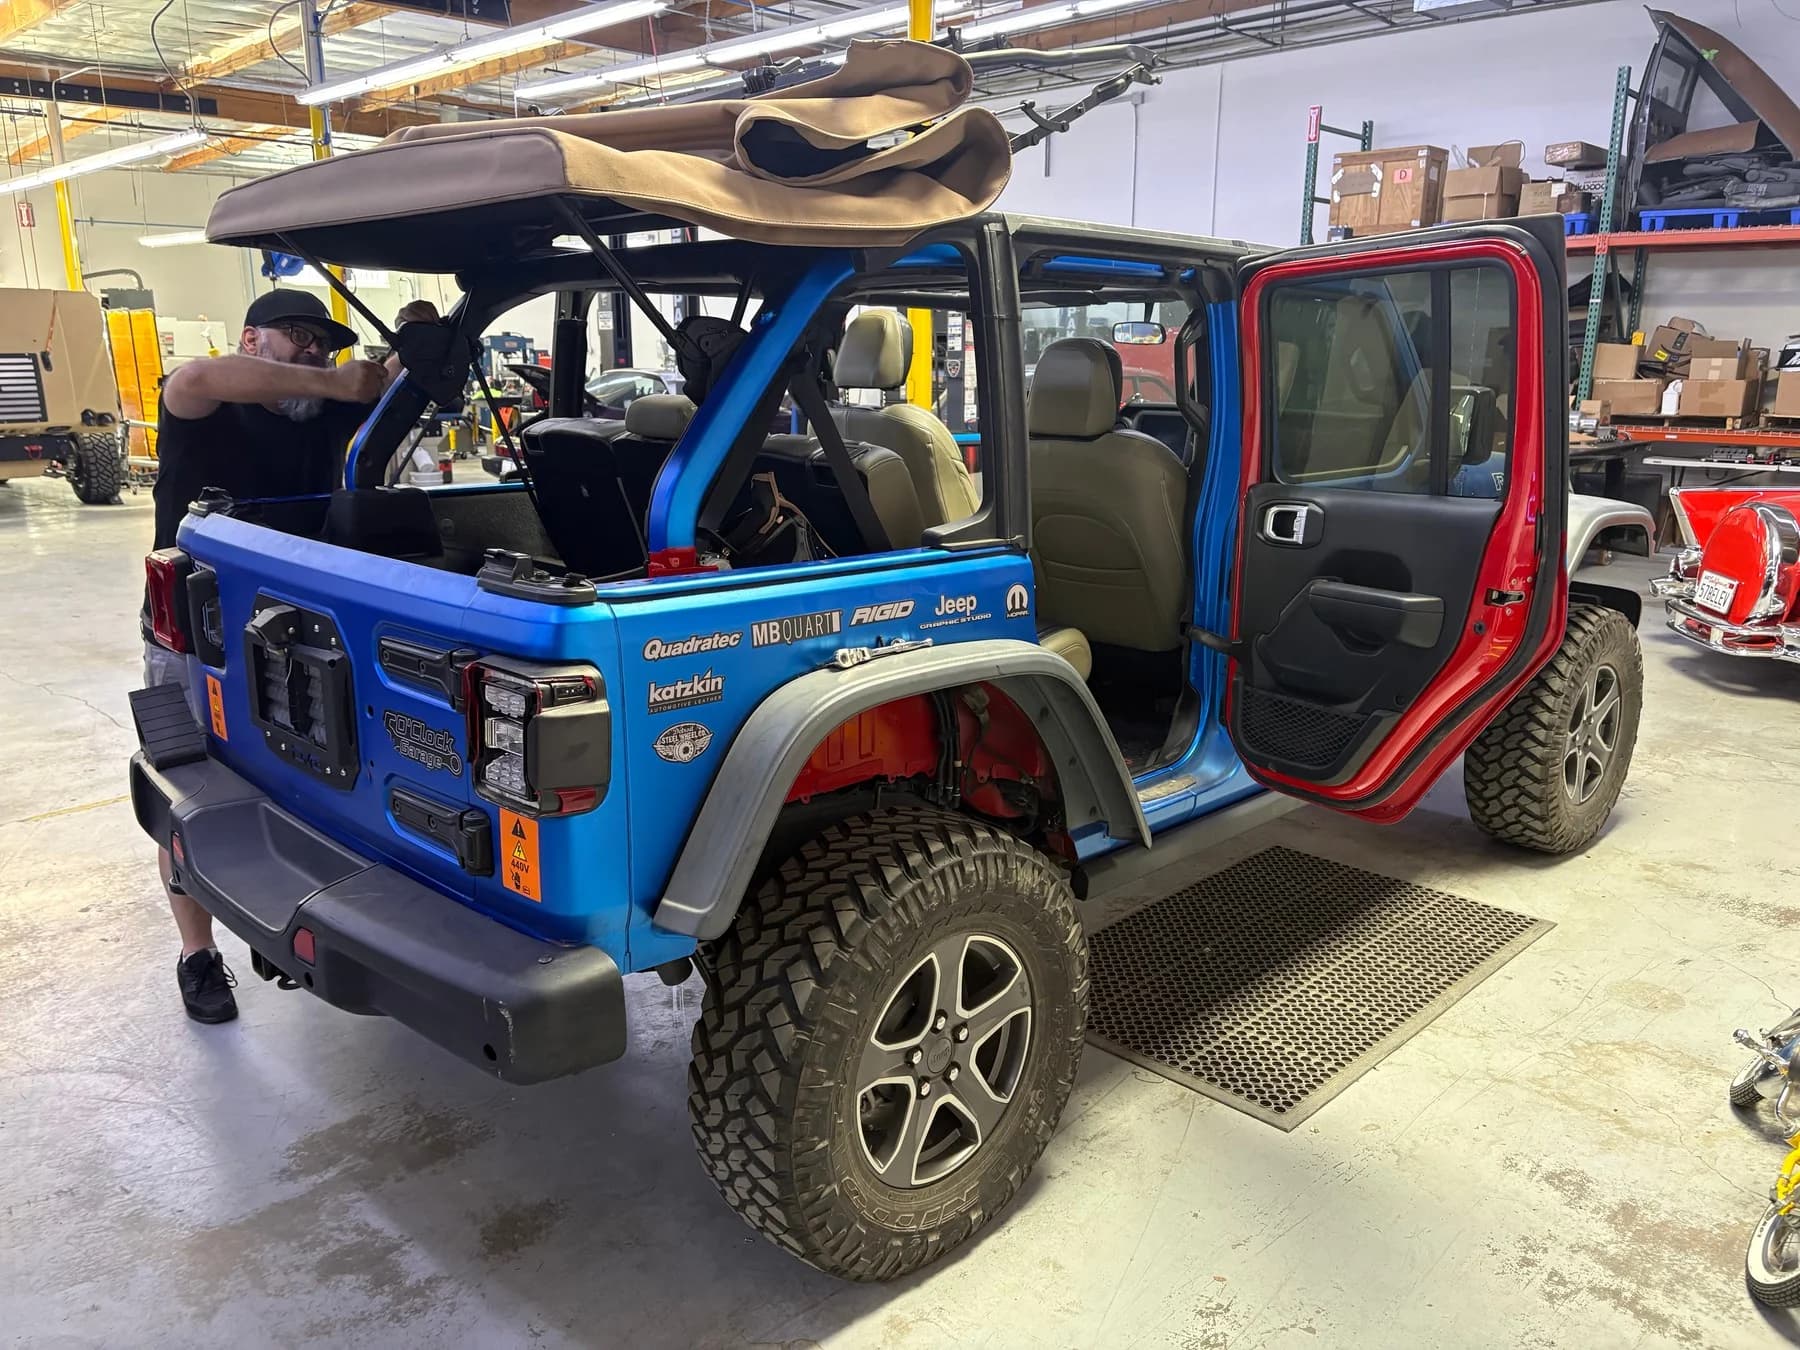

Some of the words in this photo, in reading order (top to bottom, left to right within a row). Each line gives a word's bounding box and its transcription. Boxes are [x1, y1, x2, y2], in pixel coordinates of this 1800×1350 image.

[1399, 170, 1408, 181] D
[850, 600, 915, 627] RIGID
[935, 595, 977, 616] Jeep
[920, 618, 960, 630] GRAPHIC
[960, 613, 992, 623] STUDIO
[643, 632, 742, 661] Quadratec
[650, 668, 723, 703] katzkin
[650, 701, 690, 713] AUTOMOTIVE
[694, 695, 722, 705] LEATHER
[400, 739, 443, 769] Garage
[510, 859, 530, 874] 440V
